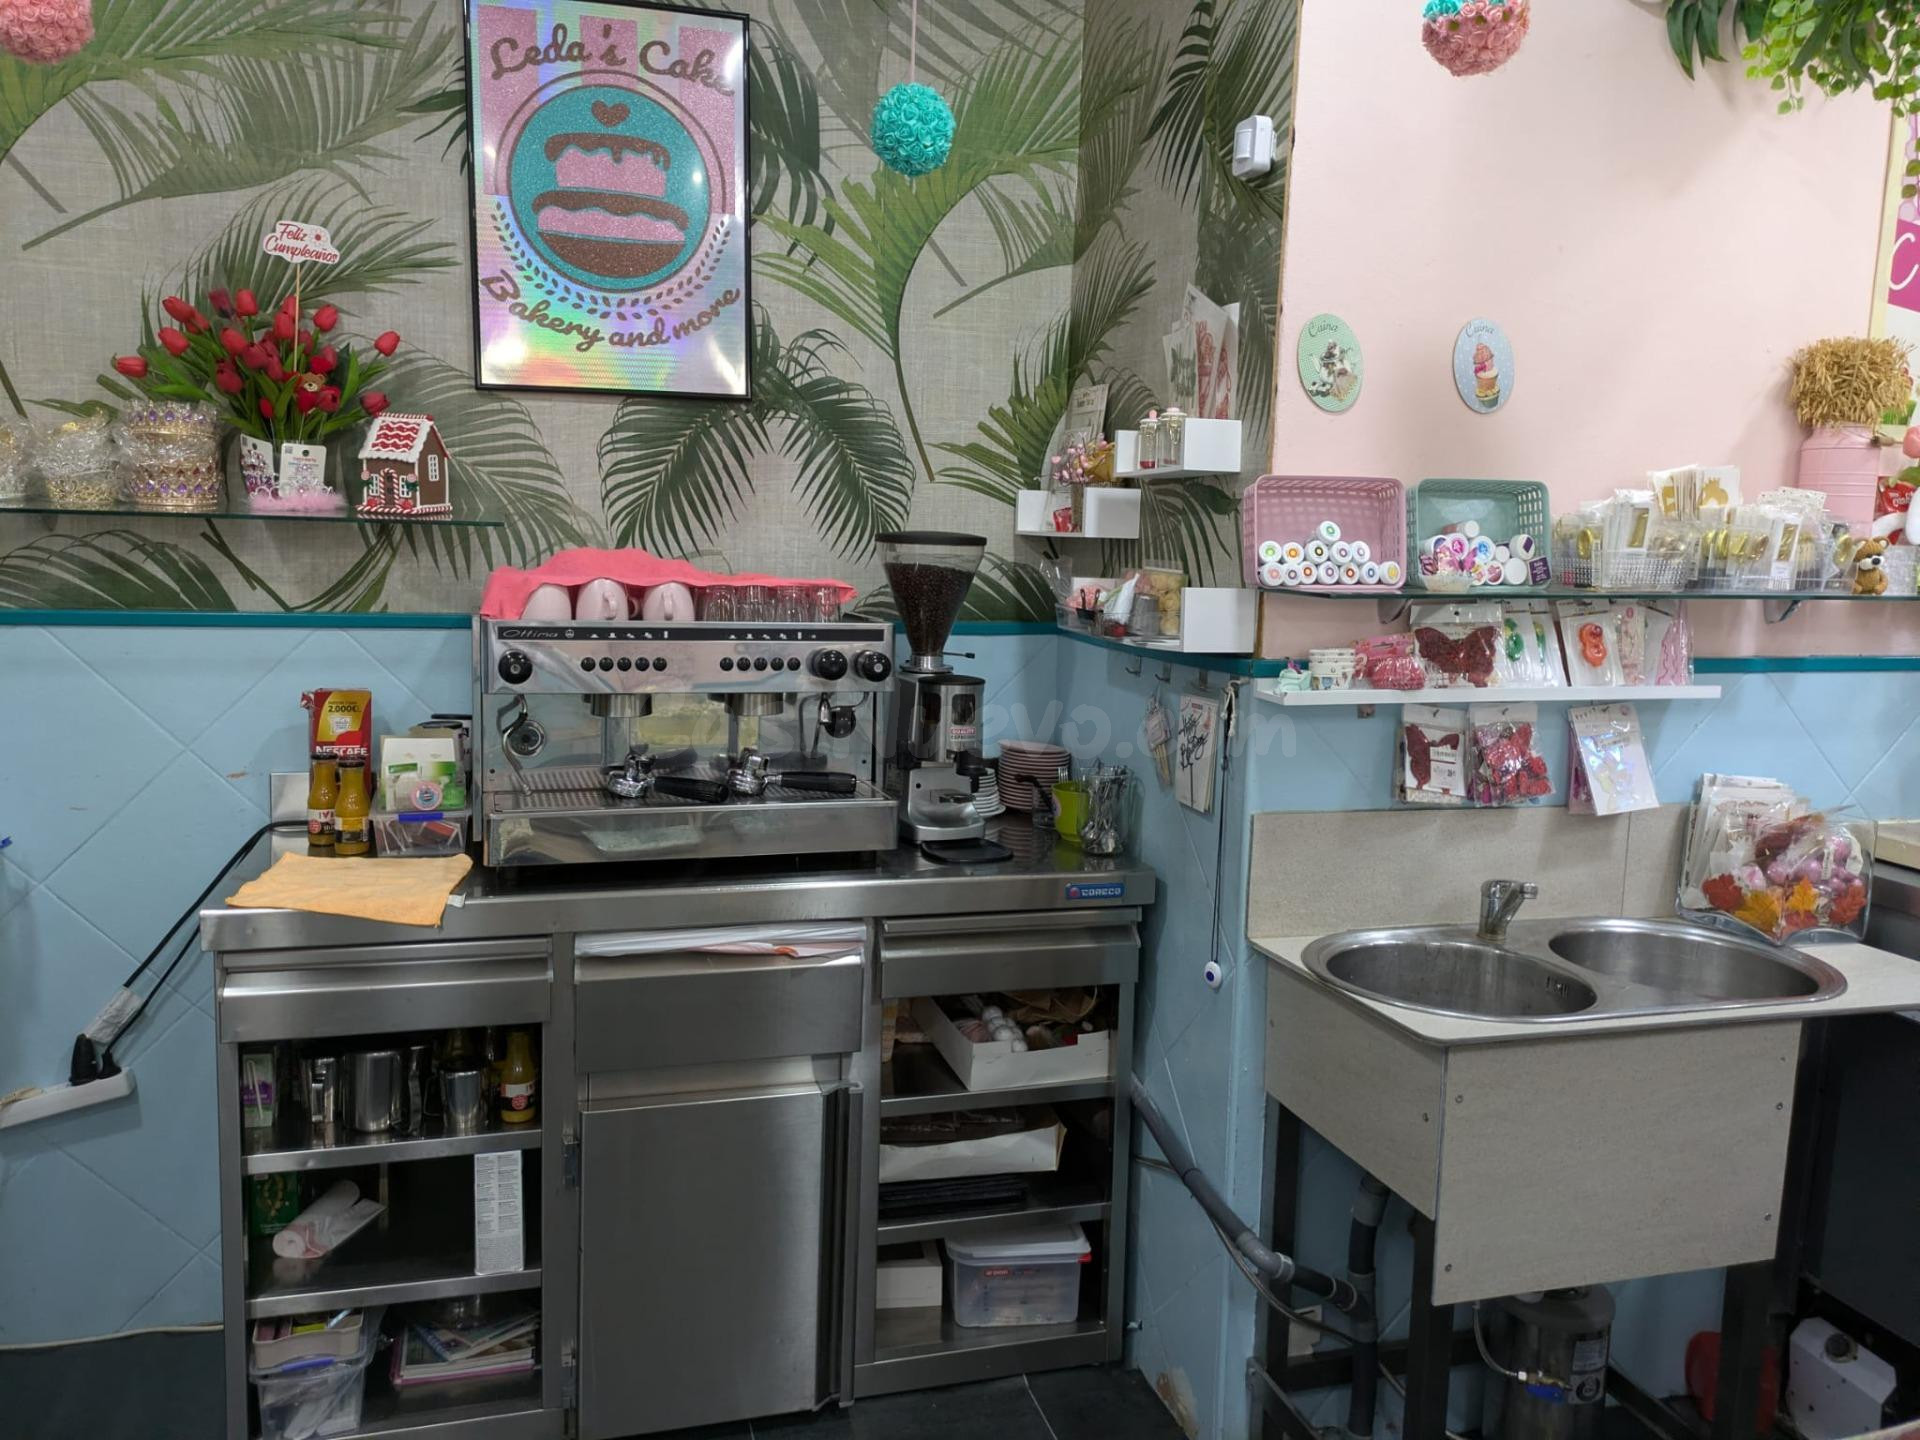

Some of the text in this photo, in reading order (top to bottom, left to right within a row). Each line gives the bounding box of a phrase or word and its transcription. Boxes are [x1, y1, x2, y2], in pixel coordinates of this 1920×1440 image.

[639, 40, 735, 97] Cake
[264, 234, 338, 262] Cumpleaños
[279, 222, 307, 242] Feliz
[480, 269, 741, 352] Bakery and more
